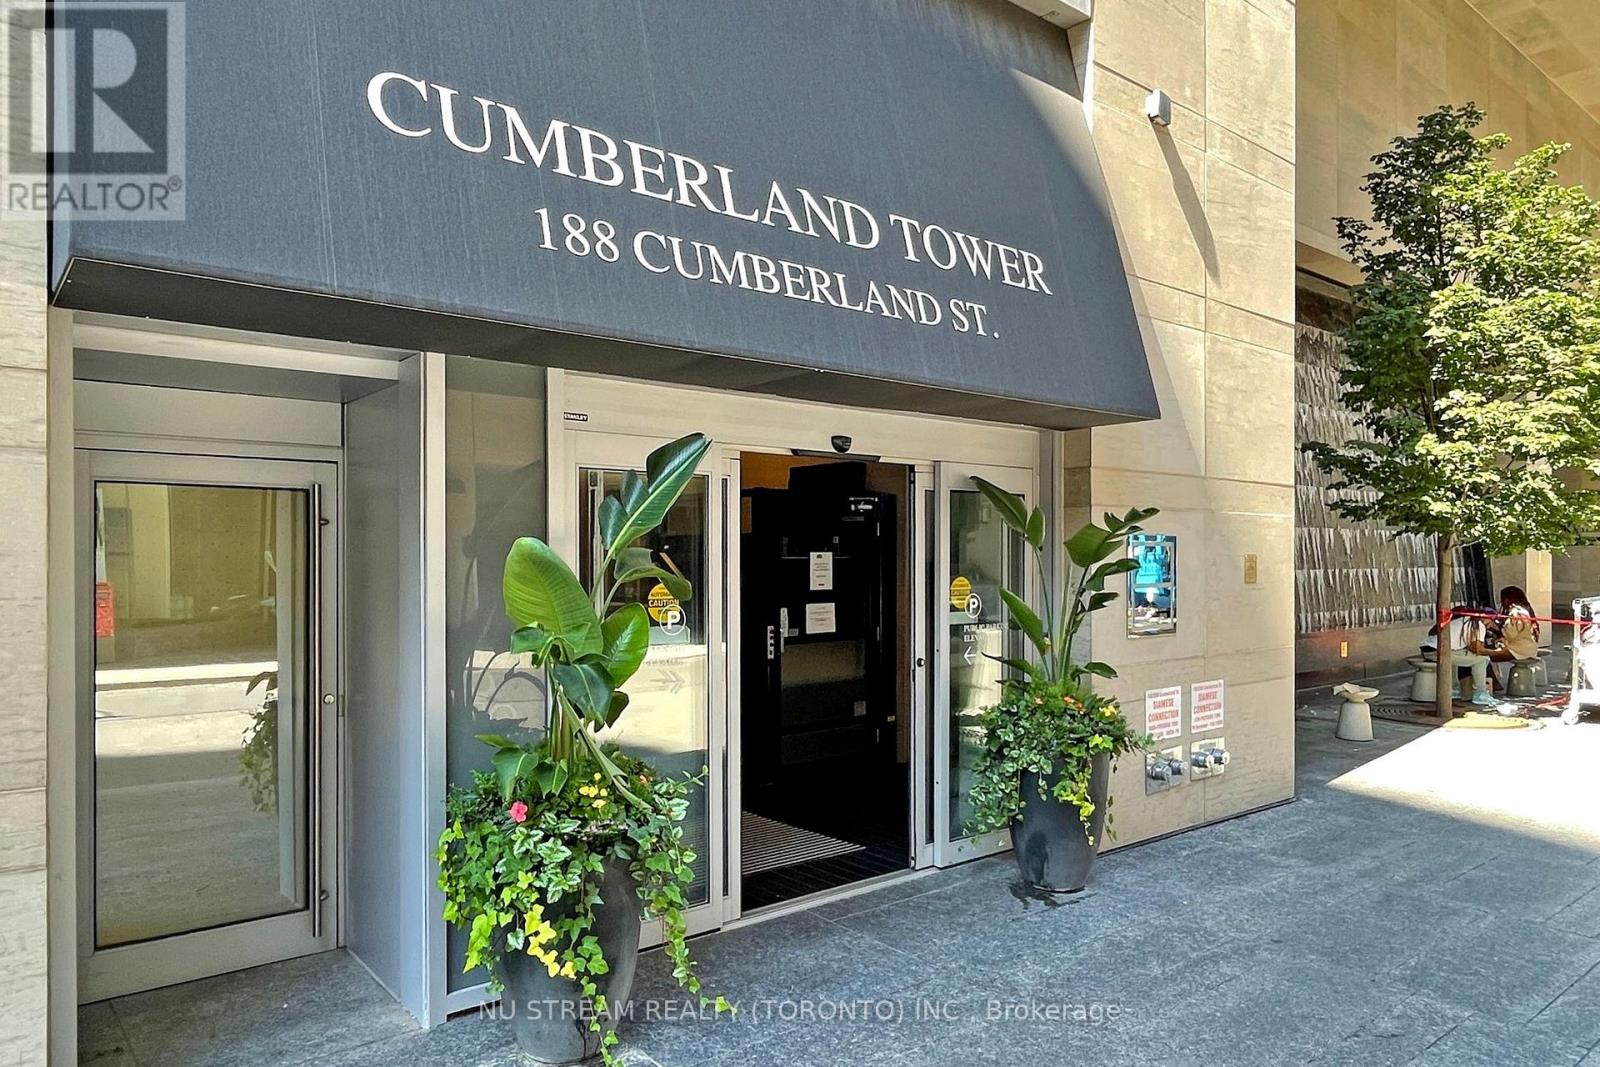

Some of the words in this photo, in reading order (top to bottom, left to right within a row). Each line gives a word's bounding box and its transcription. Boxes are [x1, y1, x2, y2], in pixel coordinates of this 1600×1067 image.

[366, 71, 880, 249] CUMBERLAND
[889, 213, 1053, 295] TOWER
[534, 207, 620, 262] 188
[633, 230, 942, 326] CUMBERLAND
[949, 298, 1000, 339] ST.
[667, 610, 681, 630] P
[1148, 710, 1179, 722] CONNECTION
